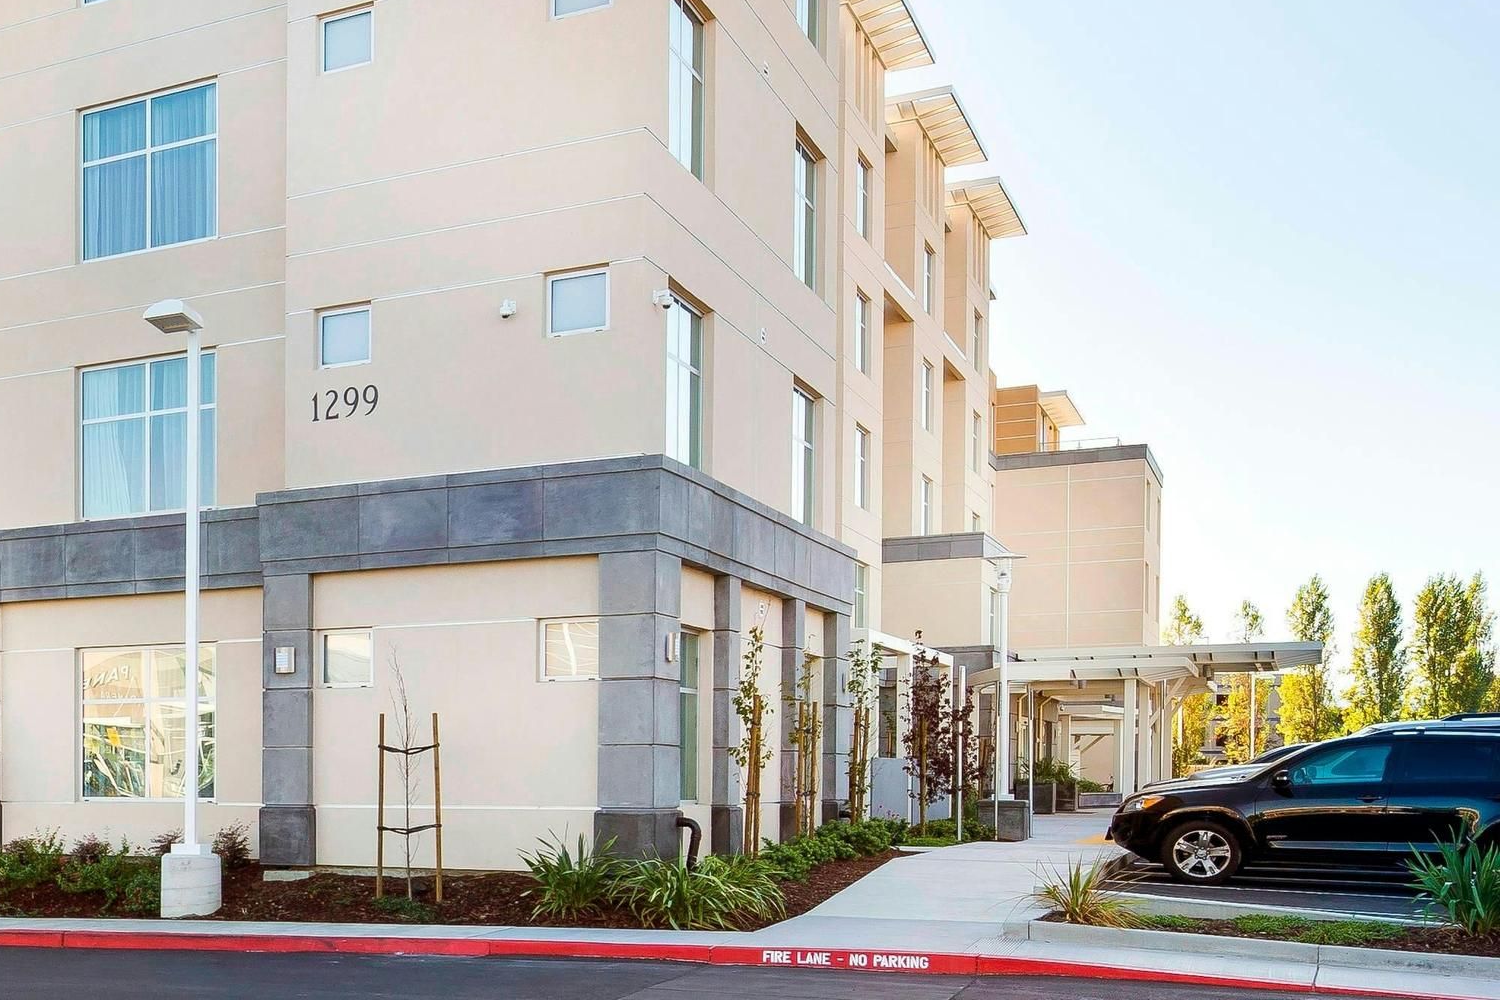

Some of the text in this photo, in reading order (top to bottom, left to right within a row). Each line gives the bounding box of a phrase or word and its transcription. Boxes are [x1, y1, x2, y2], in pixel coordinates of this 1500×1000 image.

[311, 384, 379, 422] 1299
[762, 950, 792, 964] FIRE
[797, 951, 831, 965] LANE
[849, 953, 868, 967] NO
[873, 954, 929, 969] PARKING
